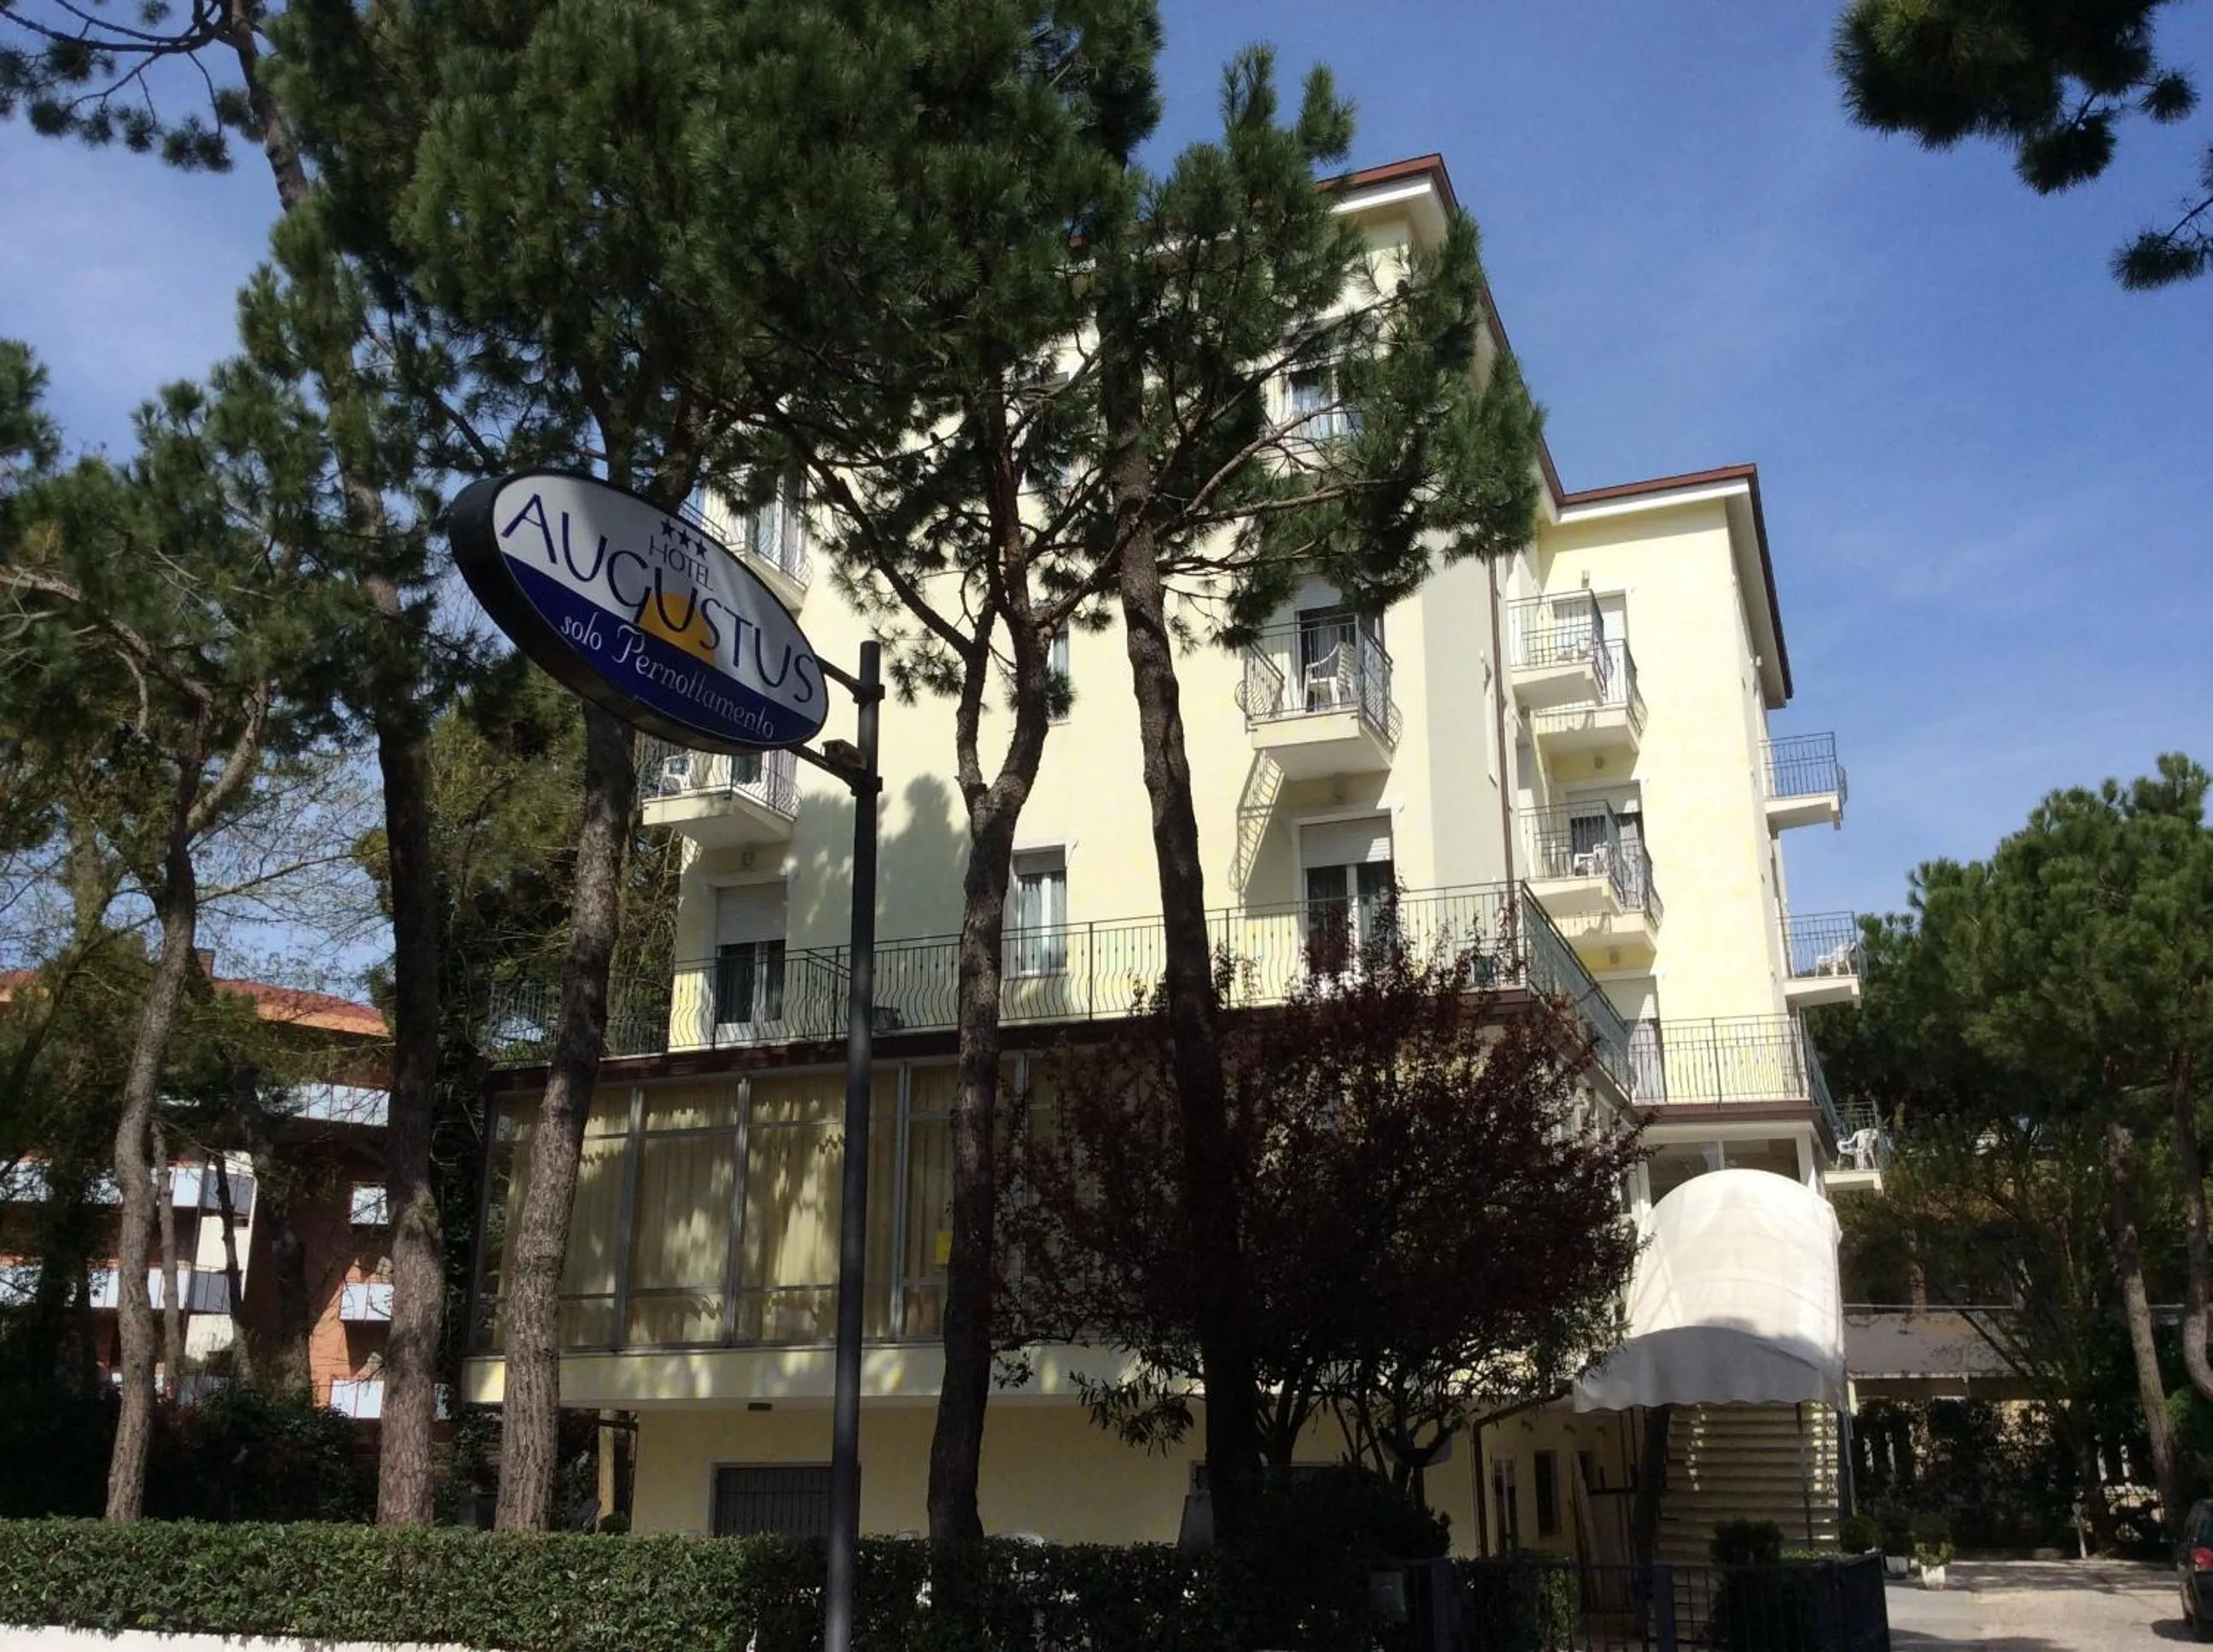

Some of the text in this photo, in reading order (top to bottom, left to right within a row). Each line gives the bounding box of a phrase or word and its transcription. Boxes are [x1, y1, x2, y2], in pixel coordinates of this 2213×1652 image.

[501, 493, 816, 703] AUGUSTUS
[649, 534, 714, 591] HOTEL
[560, 610, 775, 739] solo Pernottamento
